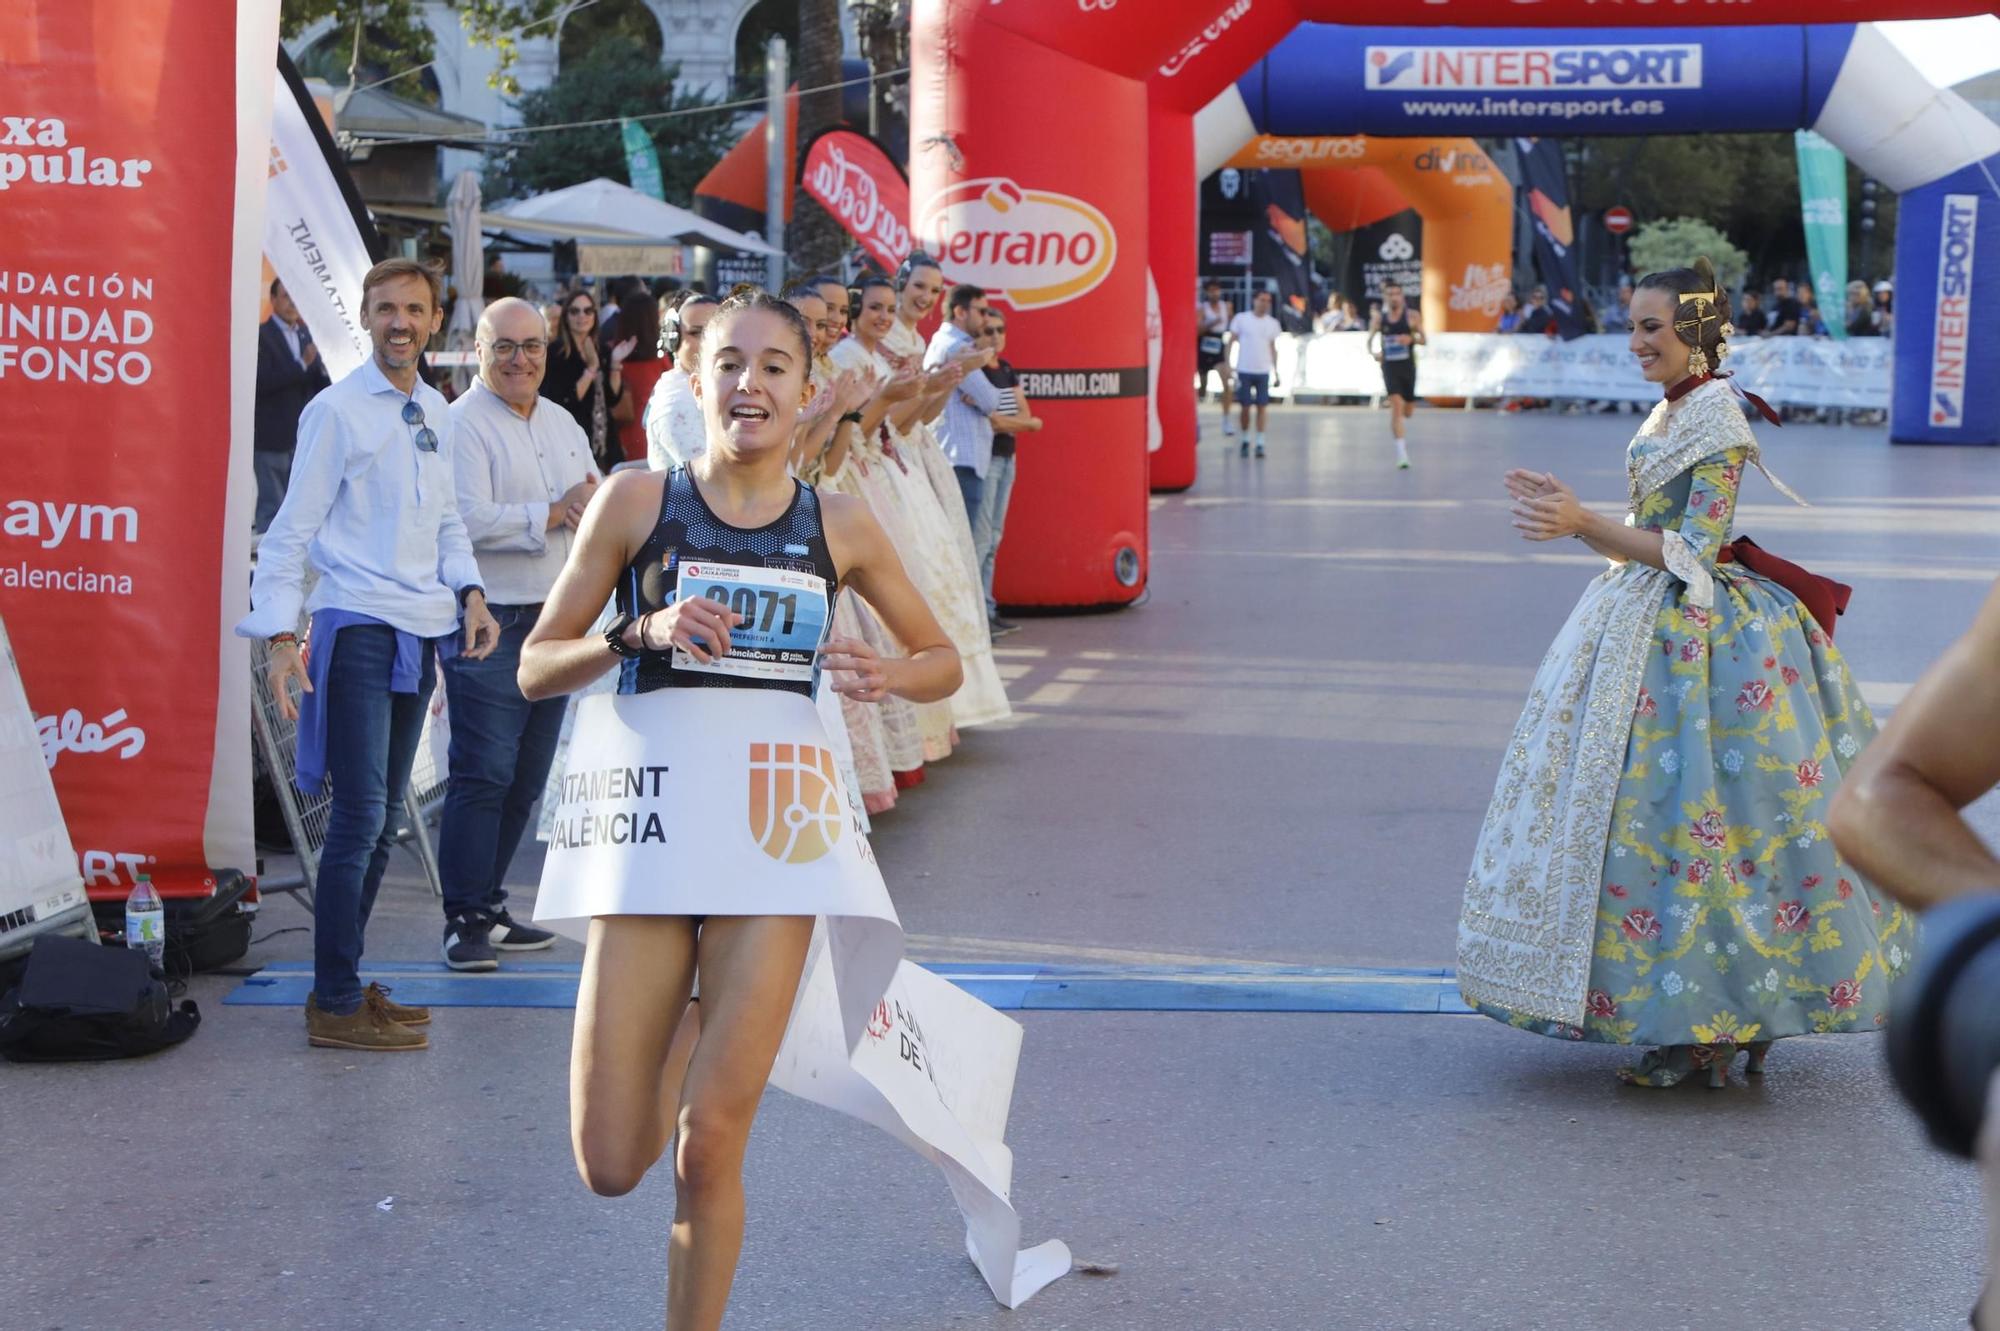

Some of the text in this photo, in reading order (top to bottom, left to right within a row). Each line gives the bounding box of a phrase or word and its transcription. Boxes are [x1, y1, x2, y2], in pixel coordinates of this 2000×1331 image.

[1422, 48, 1689, 87] INTERSPORT
[1403, 97, 1665, 119] www.intersport.es
[1257, 139, 1366, 162] seguros
[1935, 203, 1974, 388] INTERSPORT
[0, 344, 152, 386] FONSO
[1018, 373, 1121, 396] ERRANO.COM
[3, 500, 138, 549] aym
[729, 648, 777, 661] lènciaCorre
[34, 708, 146, 770] glés
[83, 850, 147, 886] RT
[900, 1031, 922, 1072] DE
